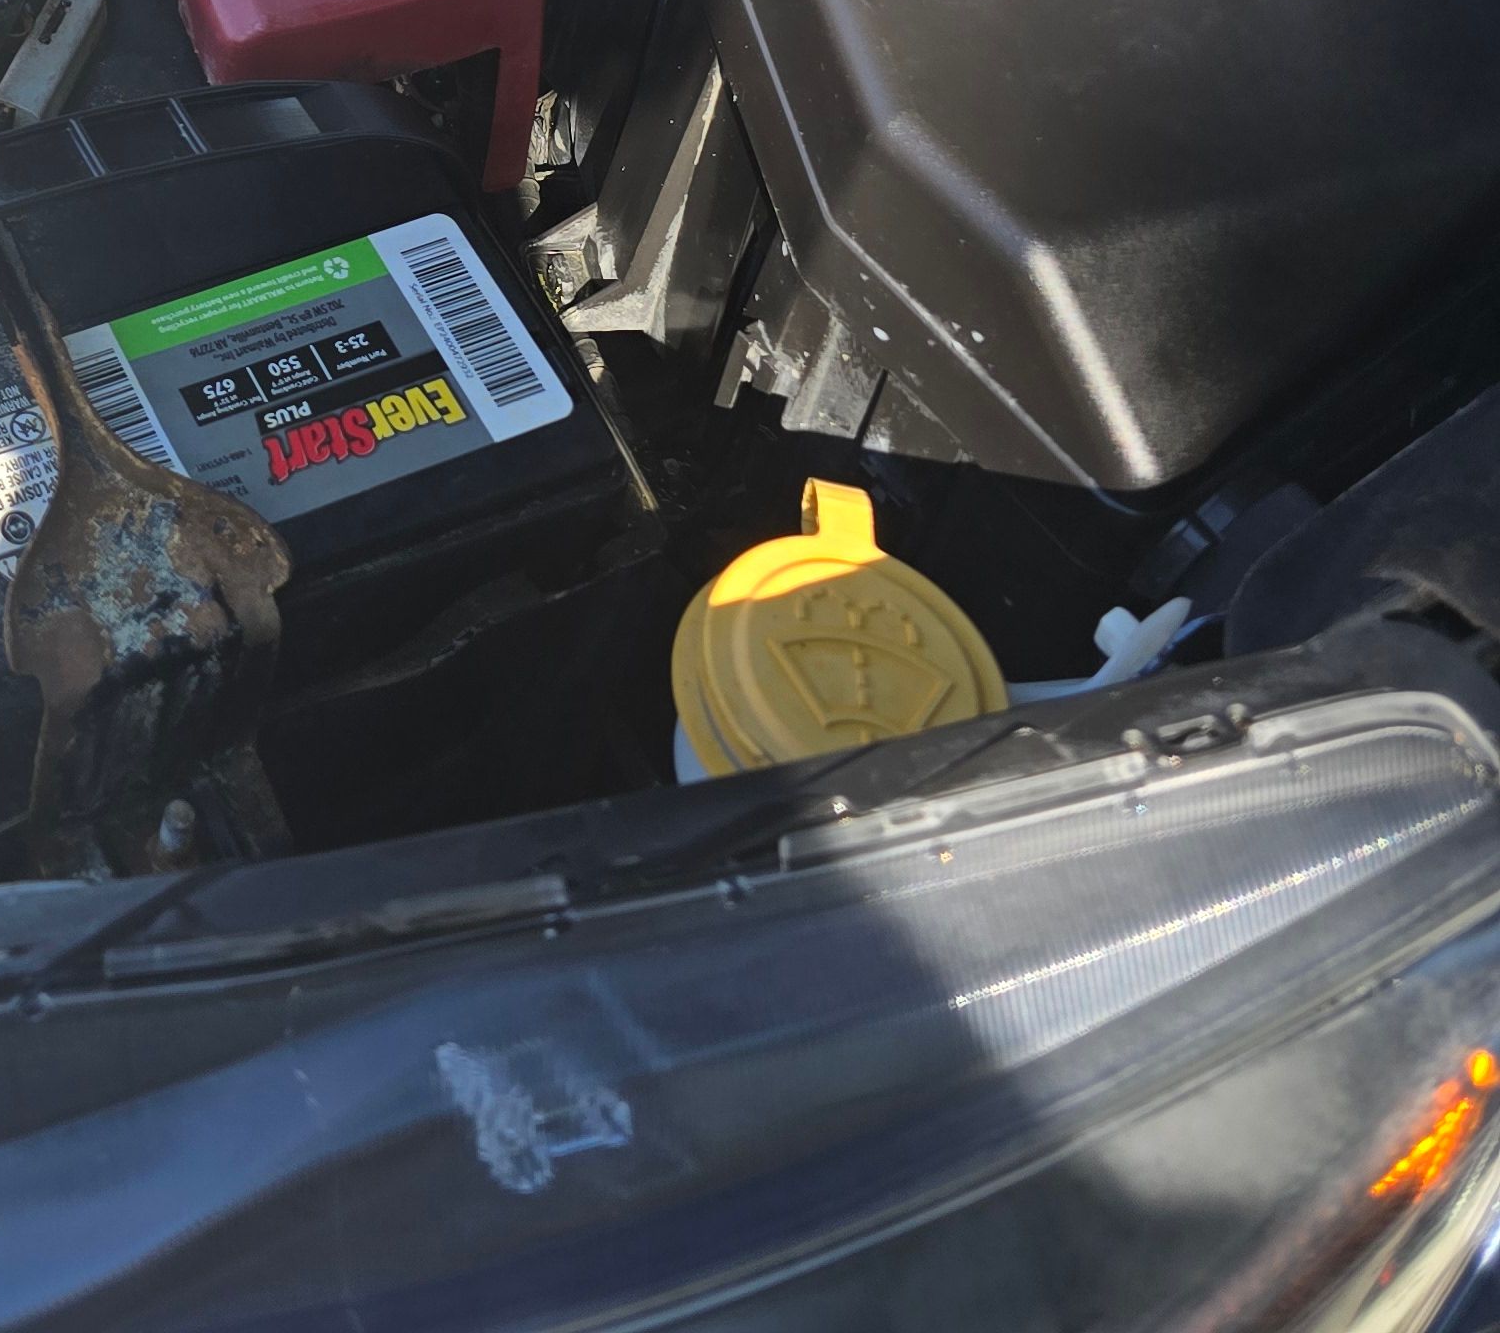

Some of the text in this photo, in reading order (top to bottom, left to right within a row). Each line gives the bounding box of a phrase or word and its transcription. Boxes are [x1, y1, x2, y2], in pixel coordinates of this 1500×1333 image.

[293, 273, 324, 289] Return
[240, 286, 285, 307] WALMART
[408, 282, 426, 303] Serial
[197, 303, 228, 320] proper
[311, 304, 327, 316] SW
[325, 298, 344, 311] 702
[157, 313, 198, 334] recycling
[226, 317, 283, 345] Bentonville,
[285, 315, 337, 340] Distributed
[213, 338, 228, 350] AR
[233, 336, 275, 358] Walmart
[272, 331, 286, 344] by
[201, 332, 369, 399] 25-3 550 675
[335, 348, 387, 371] Part Number
[262, 400, 312, 428] PLUS
[259, 375, 468, 482] EverStart
[0, 449, 42, 474] INJURY.
[39, 458, 59, 475] AN
[5, 464, 42, 487] CAUSE
[4, 475, 61, 507] PLOSIVE
